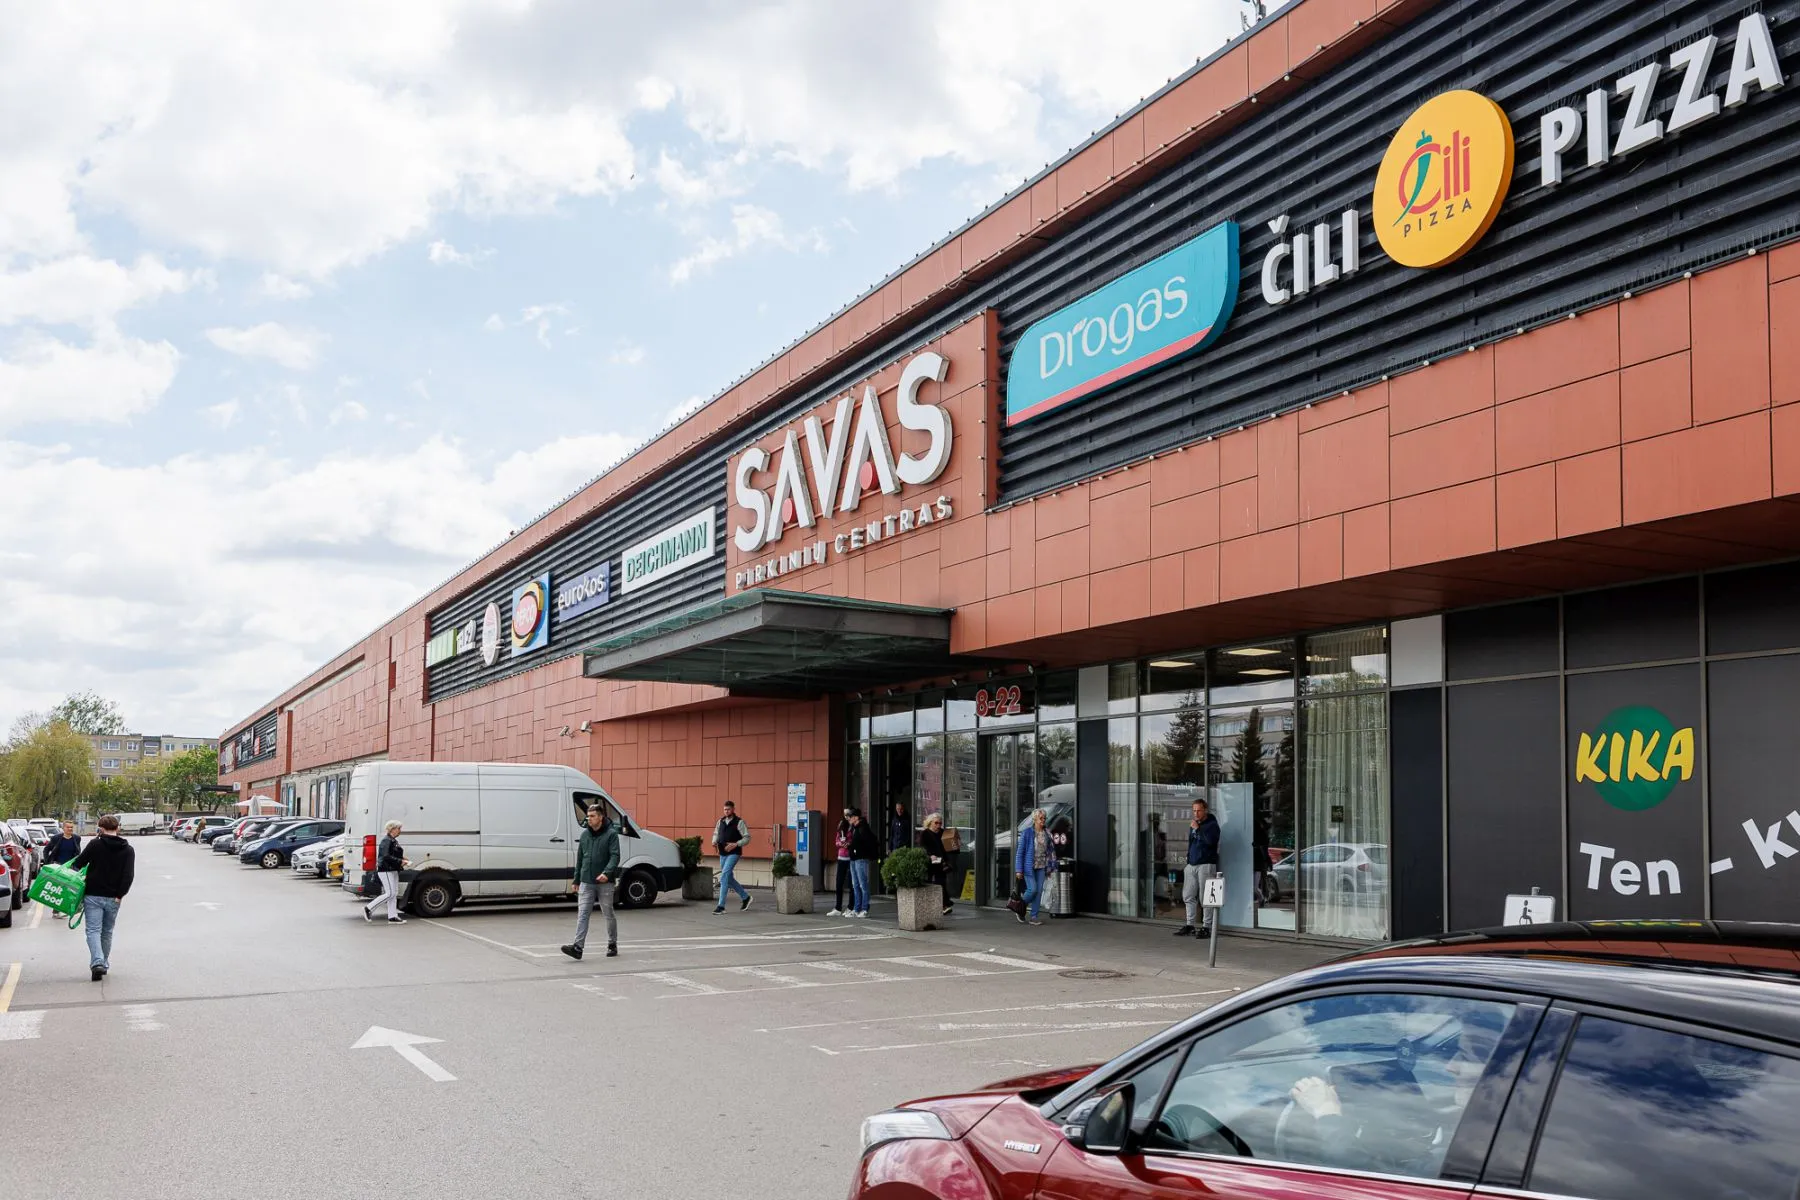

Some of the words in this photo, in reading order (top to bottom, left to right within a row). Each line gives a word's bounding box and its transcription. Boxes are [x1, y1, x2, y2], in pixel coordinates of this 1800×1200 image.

[1261, 208, 1360, 305] ČILI
[1540, 12, 1785, 187] PIZZA
[1403, 197, 1473, 238] PIZZA
[1039, 275, 1189, 380] Drogas
[734, 351, 953, 552] SAVAS
[626, 521, 707, 583] DEICHMANN
[834, 495, 953, 555] CENTRAS
[557, 573, 607, 611] eurokos
[975, 685, 1021, 717] 8-22
[1575, 727, 1696, 783] KIKA
[44, 881, 64, 896] Bolt
[1579, 841, 1682, 896] Ten
[39, 889, 64, 907] Food
